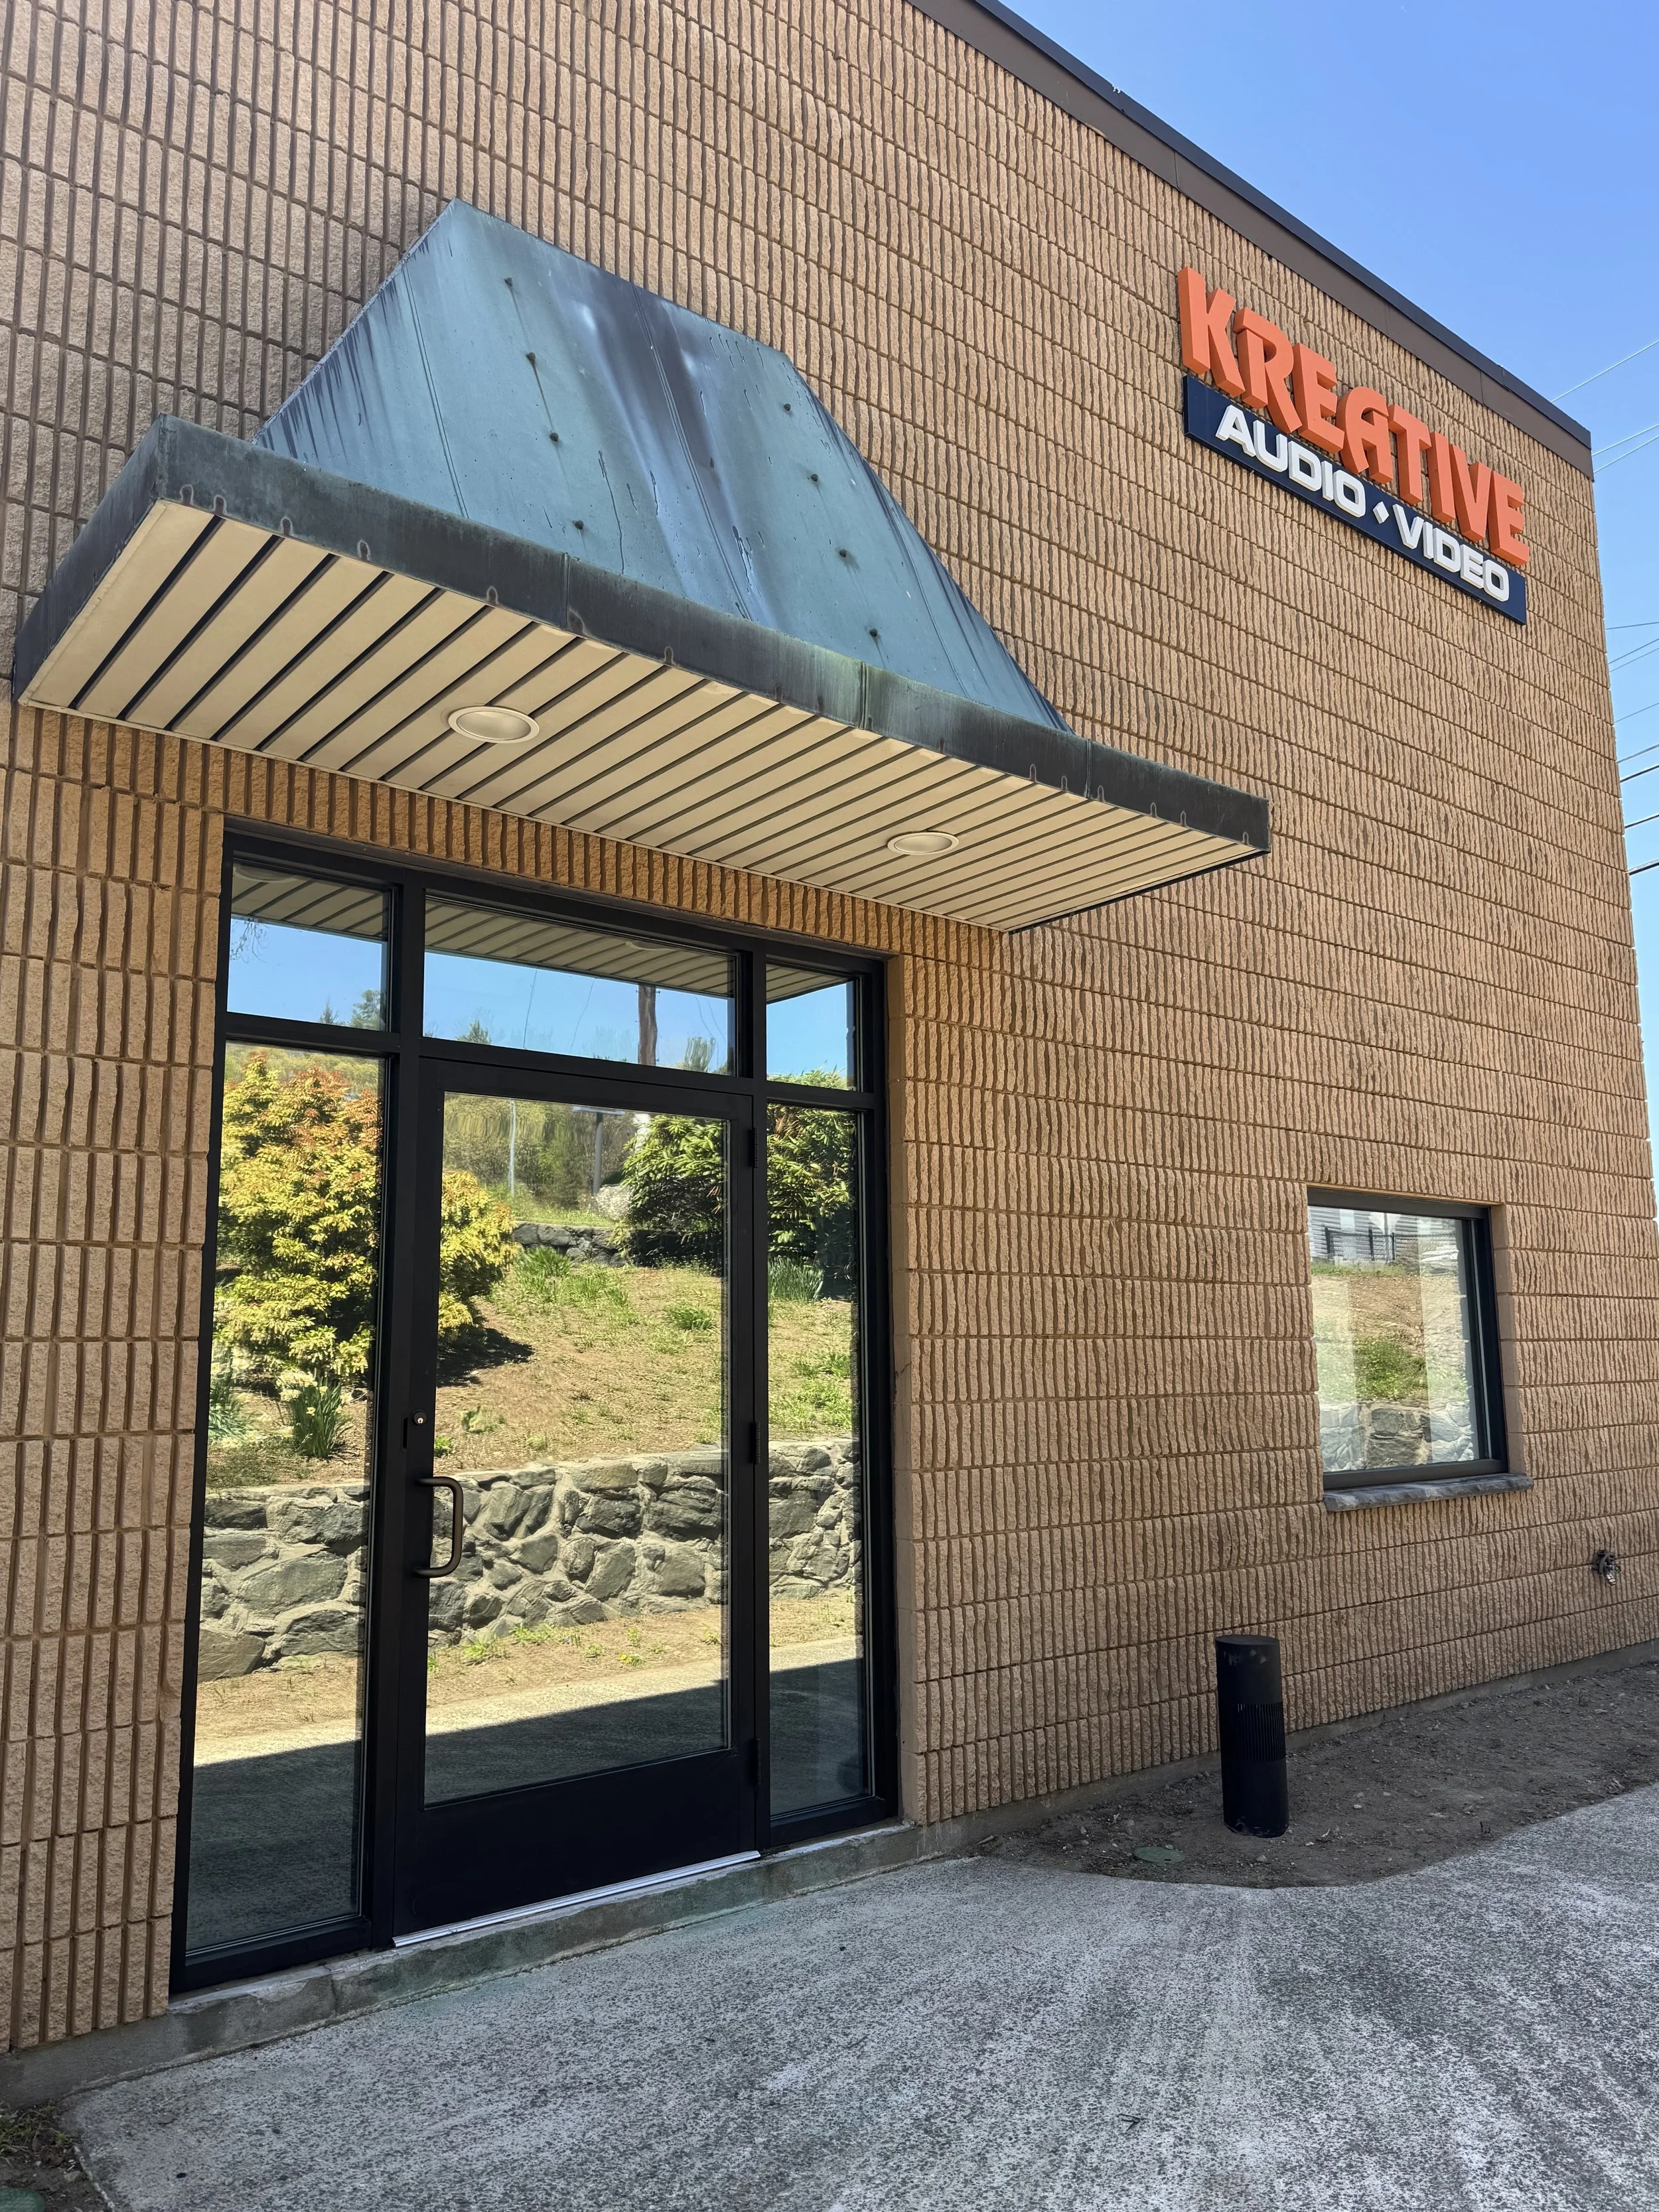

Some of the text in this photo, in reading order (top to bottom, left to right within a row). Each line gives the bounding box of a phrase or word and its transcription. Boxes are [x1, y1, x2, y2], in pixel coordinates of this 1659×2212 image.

[1177, 266, 1530, 566] KREATIVE
[1216, 405, 1509, 601] AUDIO VIDEO
